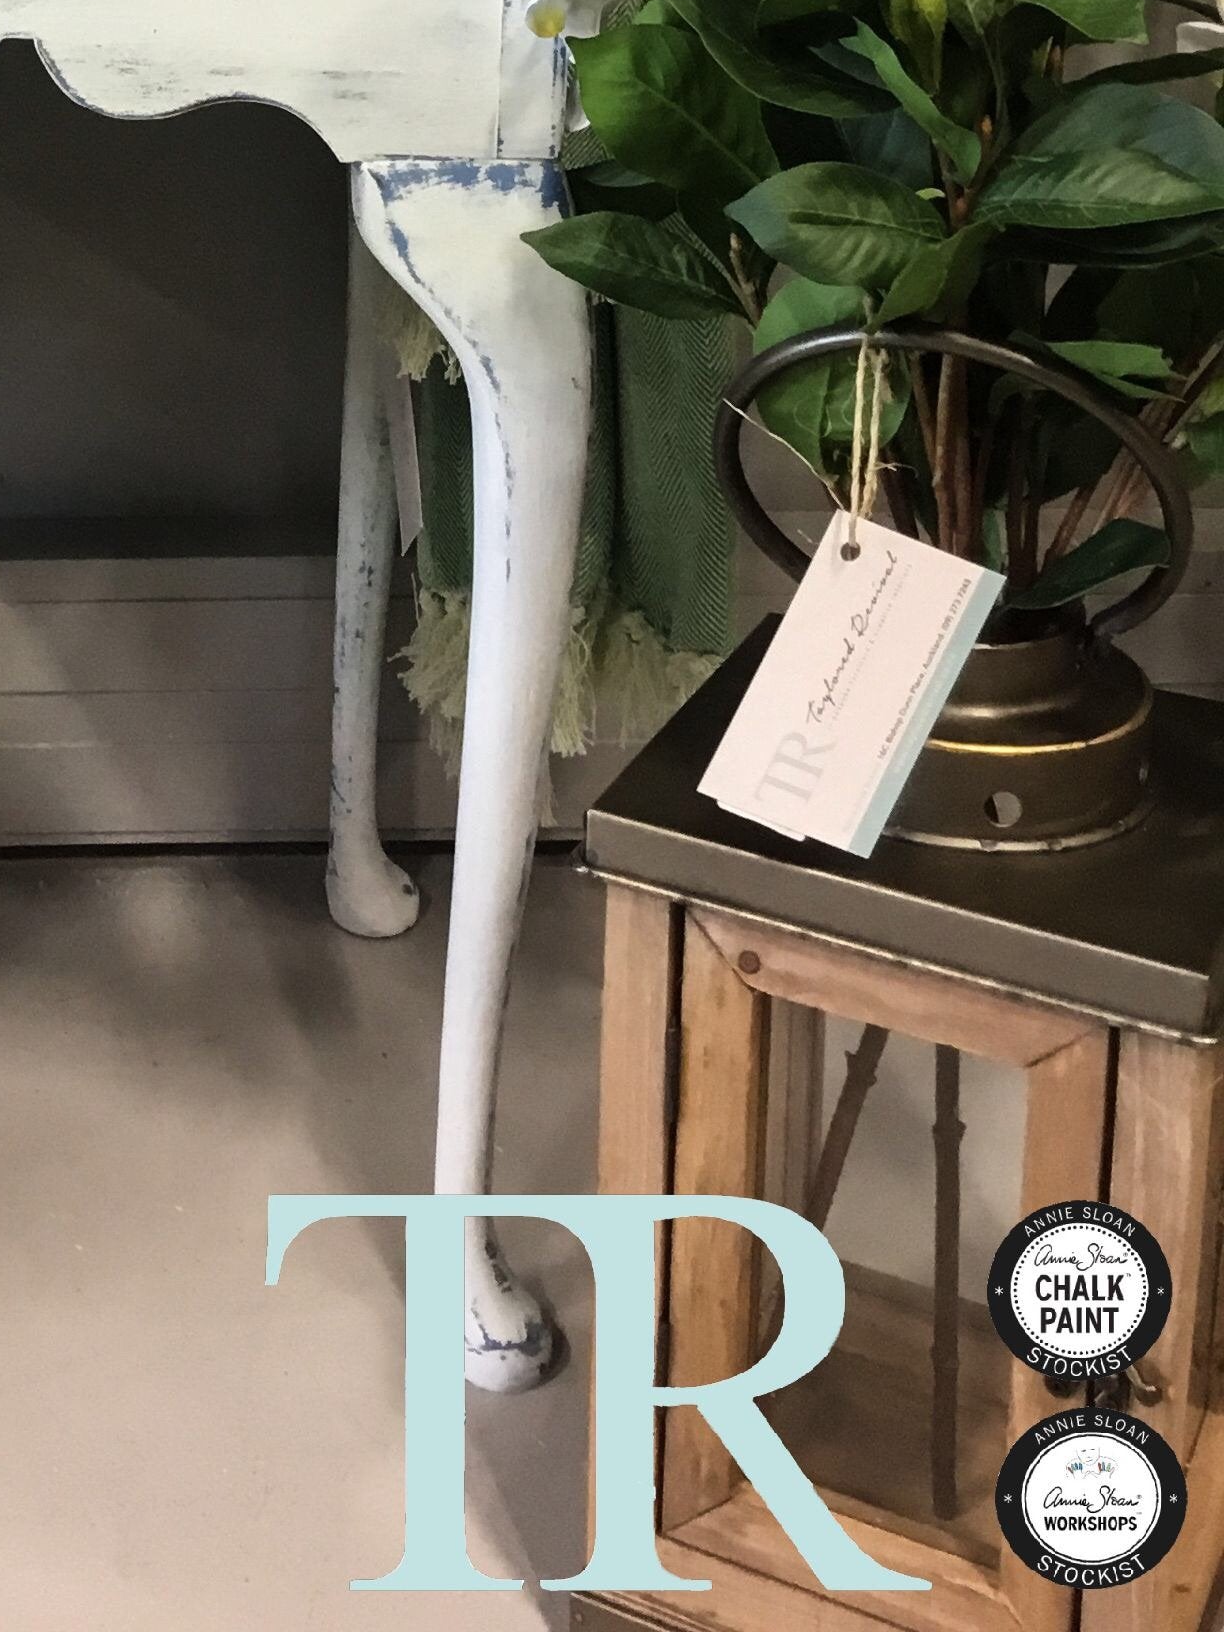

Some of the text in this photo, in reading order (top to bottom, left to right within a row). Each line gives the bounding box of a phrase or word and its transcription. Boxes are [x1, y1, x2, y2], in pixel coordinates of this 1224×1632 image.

[806, 638, 856, 724] Taylored
[851, 550, 897, 637] Revival
[754, 731, 838, 805] TR
